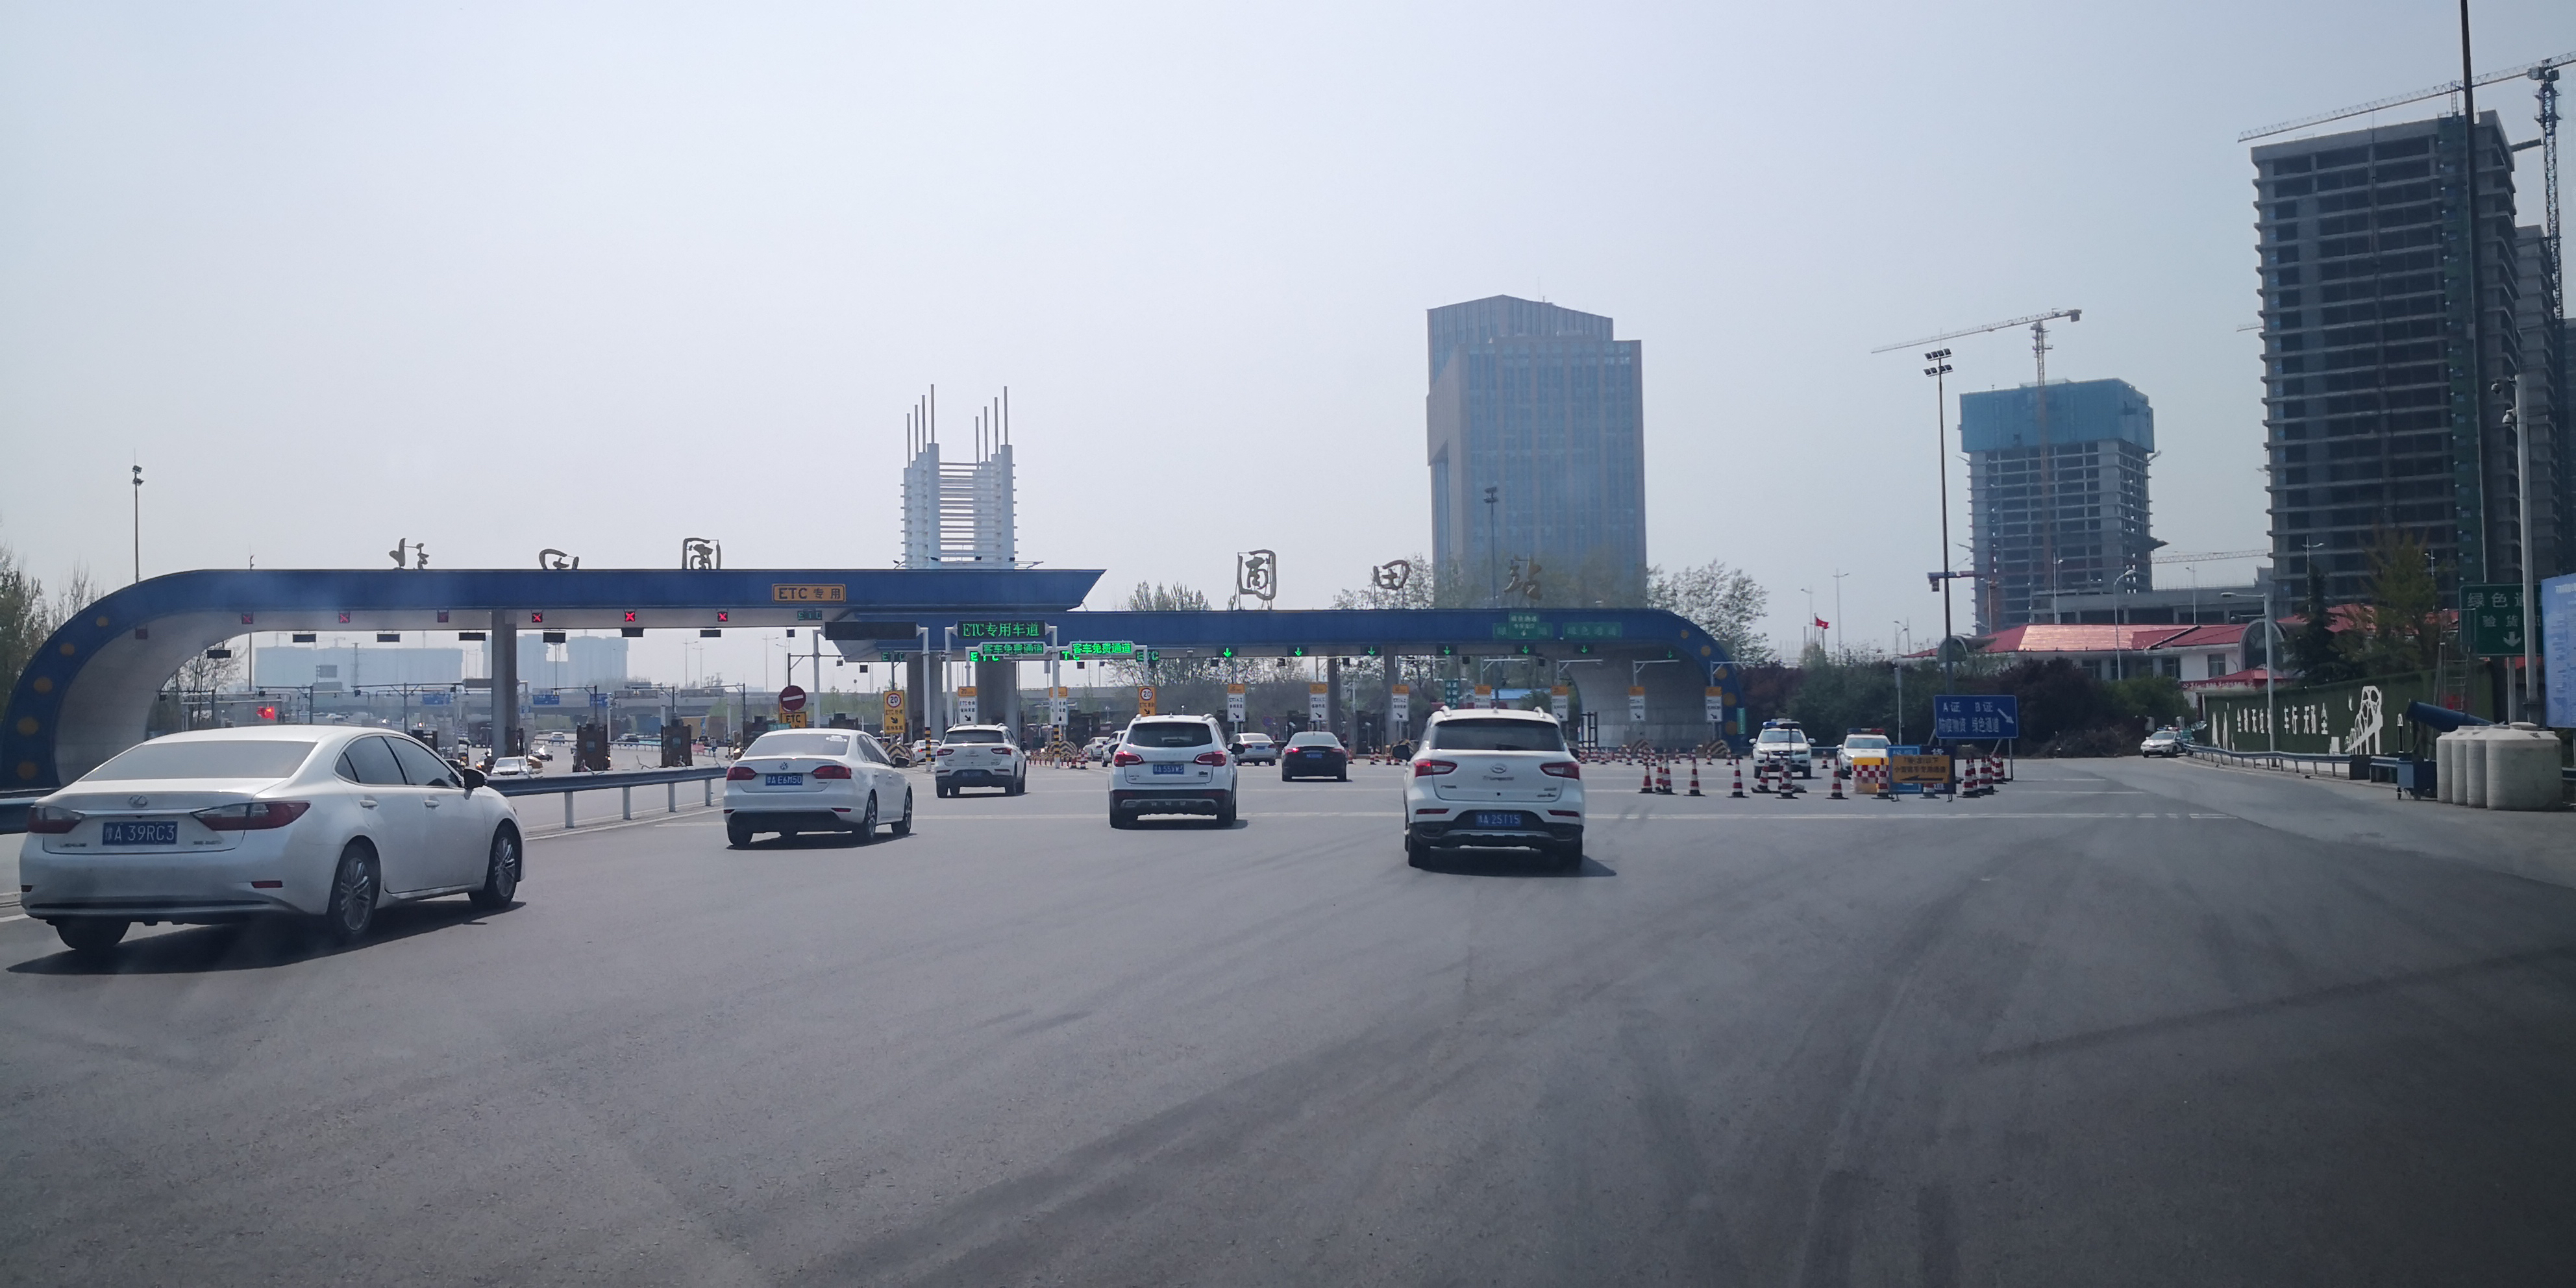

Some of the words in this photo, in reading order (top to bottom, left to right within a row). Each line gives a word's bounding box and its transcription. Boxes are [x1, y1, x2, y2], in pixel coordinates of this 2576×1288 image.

[963, 623, 1039, 636] ETC专用车道
[983, 643, 1043, 654] 客车免费通道
[1072, 643, 1132, 654] 客车免费通道
[786, 715, 800, 723] ETC
